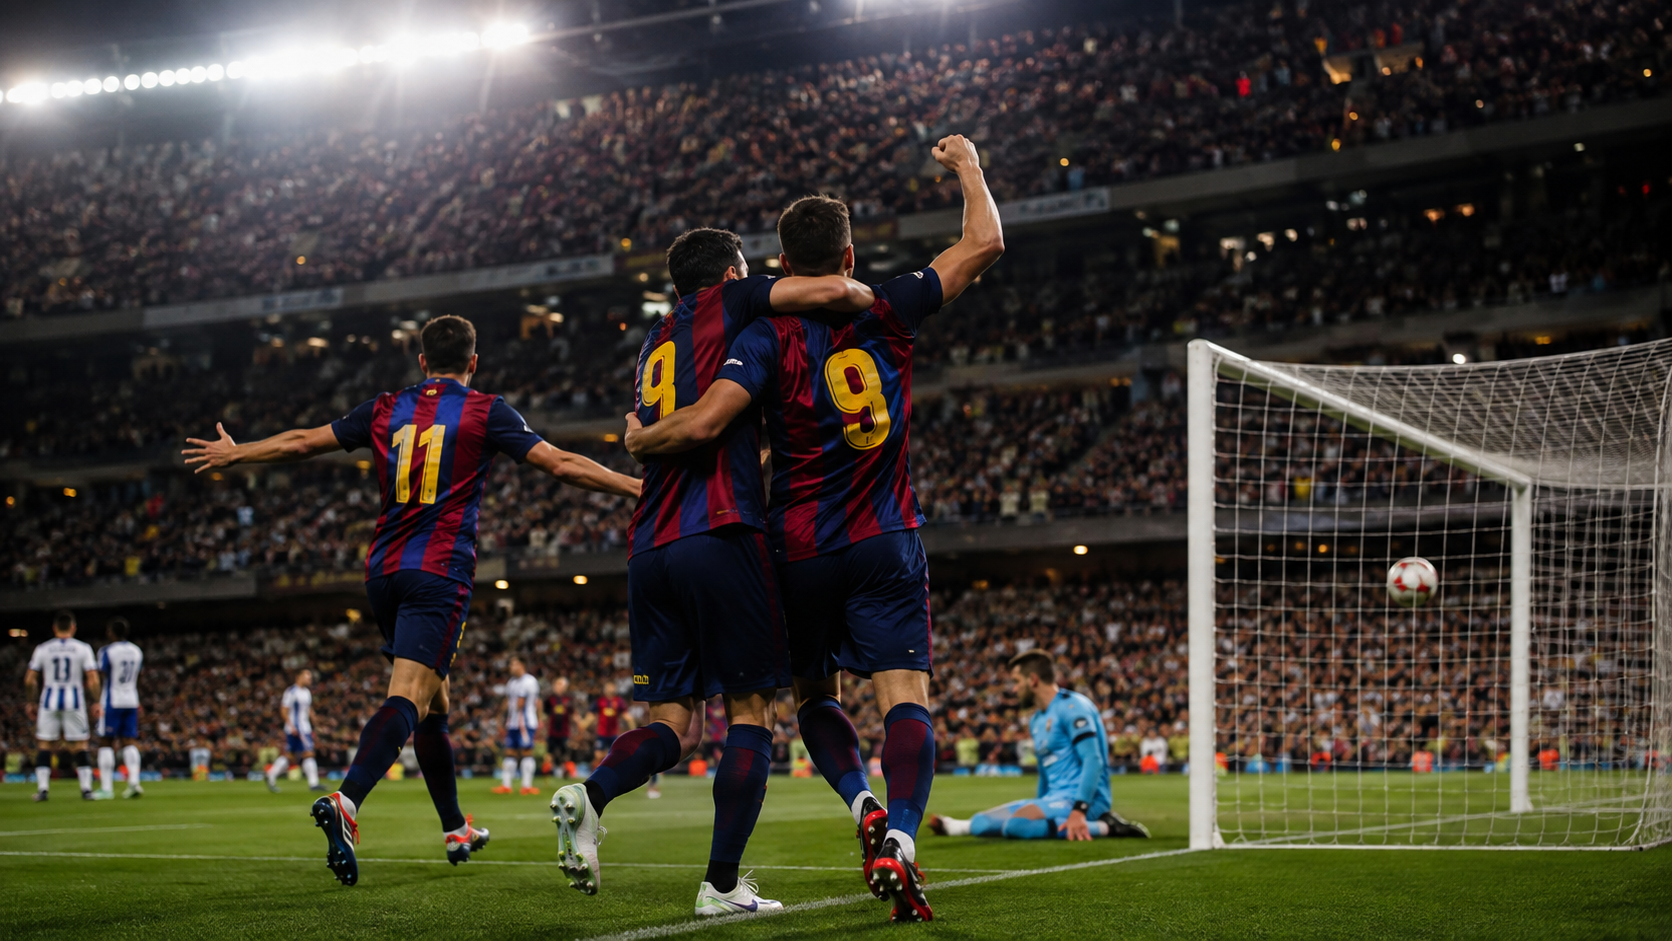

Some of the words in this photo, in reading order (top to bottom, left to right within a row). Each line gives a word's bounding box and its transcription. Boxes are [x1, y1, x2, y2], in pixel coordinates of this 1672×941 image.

[642, 340, 676, 421] 9
[824, 348, 891, 450] 9
[392, 424, 446, 505] 11
